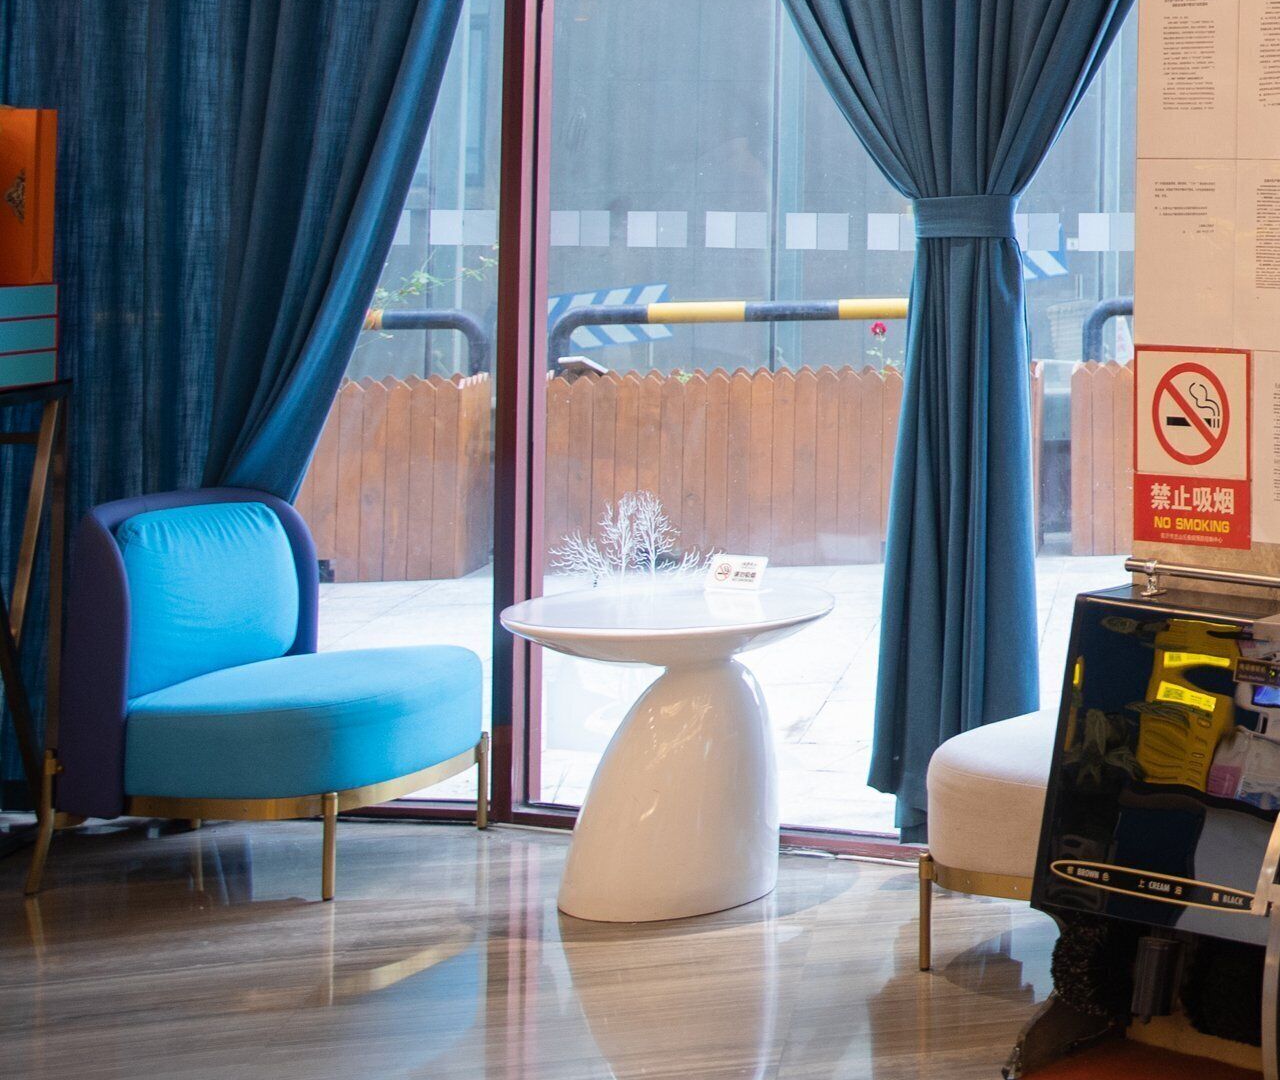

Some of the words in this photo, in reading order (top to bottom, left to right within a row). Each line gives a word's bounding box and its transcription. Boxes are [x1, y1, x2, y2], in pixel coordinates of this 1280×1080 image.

[1150, 482, 1235, 516] 禁止吸烟
[1154, 515, 1172, 529] NO
[1175, 517, 1231, 534] SMOKING
[1077, 868, 1099, 879] BROWN
[1148, 881, 1170, 892] CREAM
[1222, 894, 1244, 905] BLACK
